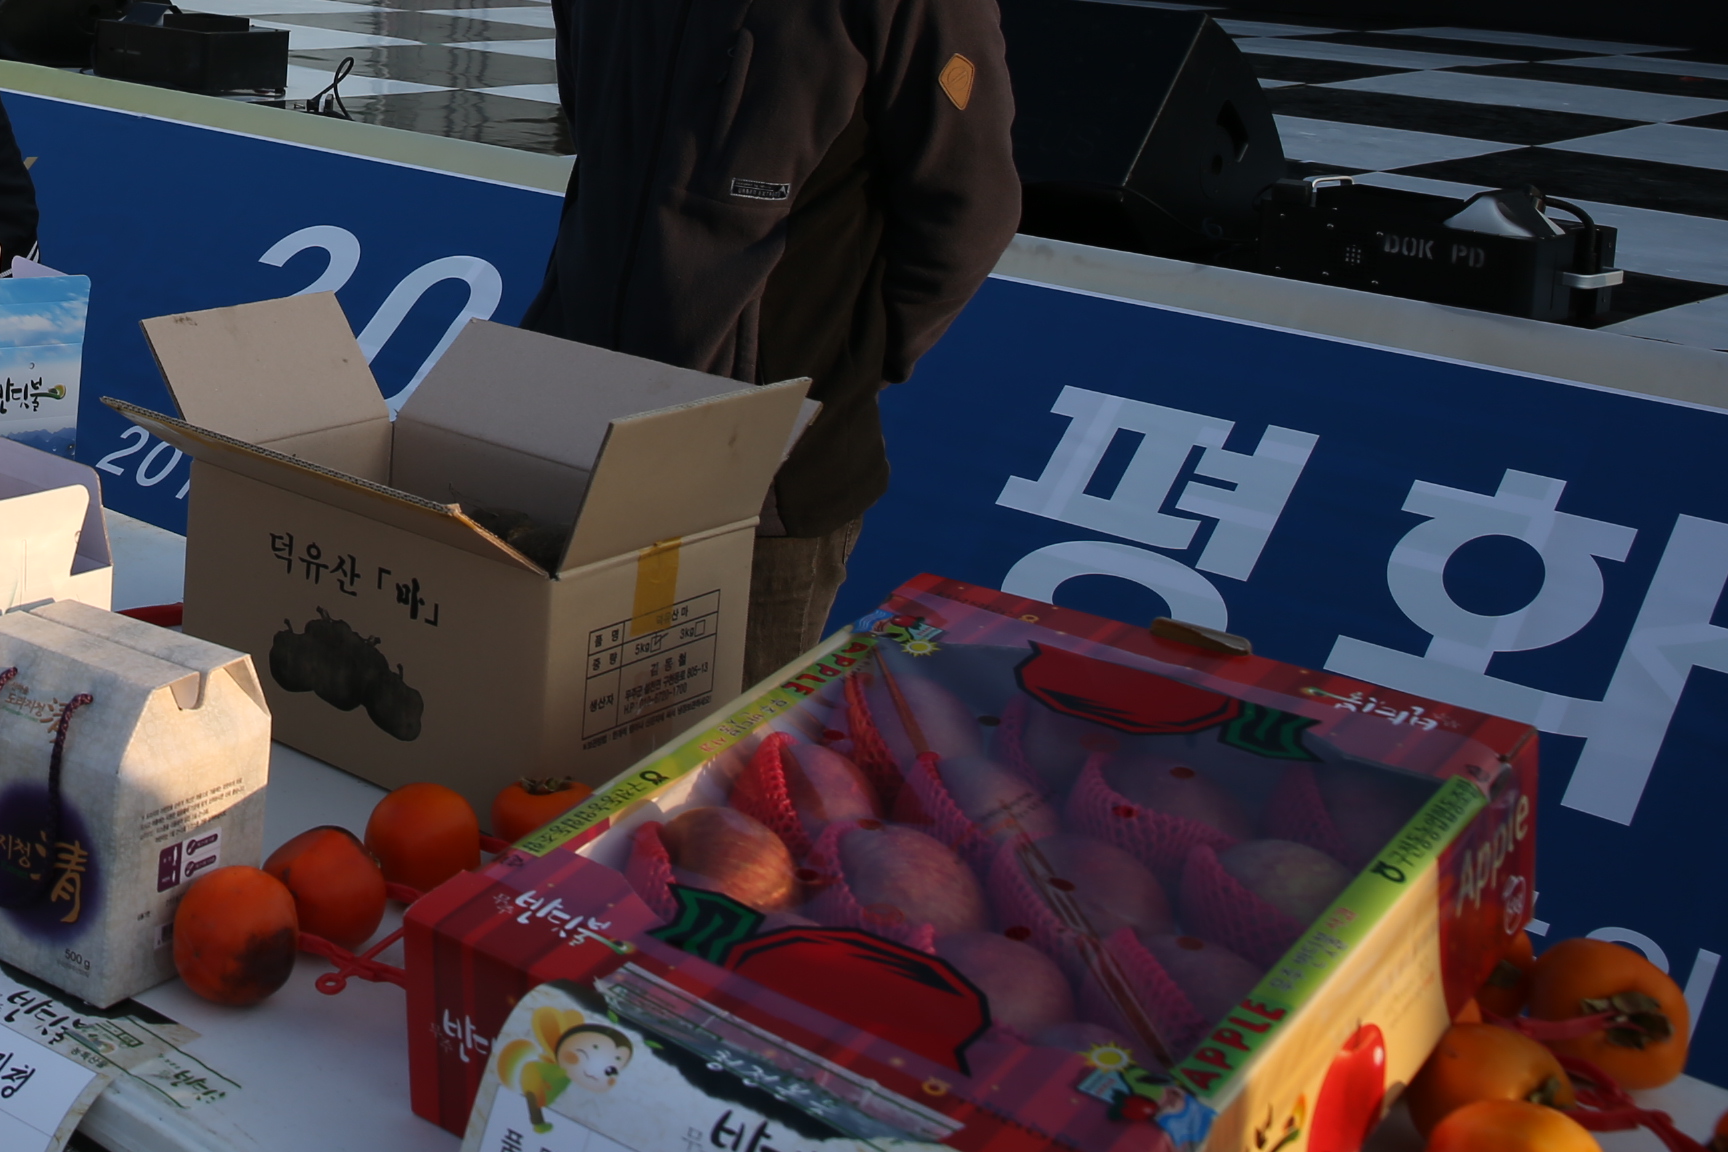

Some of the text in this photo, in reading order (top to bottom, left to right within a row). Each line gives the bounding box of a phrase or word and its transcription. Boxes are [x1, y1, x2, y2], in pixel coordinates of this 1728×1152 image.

[268, 531, 361, 597] 덕유산
[635, 627, 694, 655] 5kg 3kg
[781, 640, 870, 696] APPLE
[590, 694, 614, 712] 생산자
[1455, 794, 1530, 919] Apple
[1178, 997, 1288, 1092] APPLE
